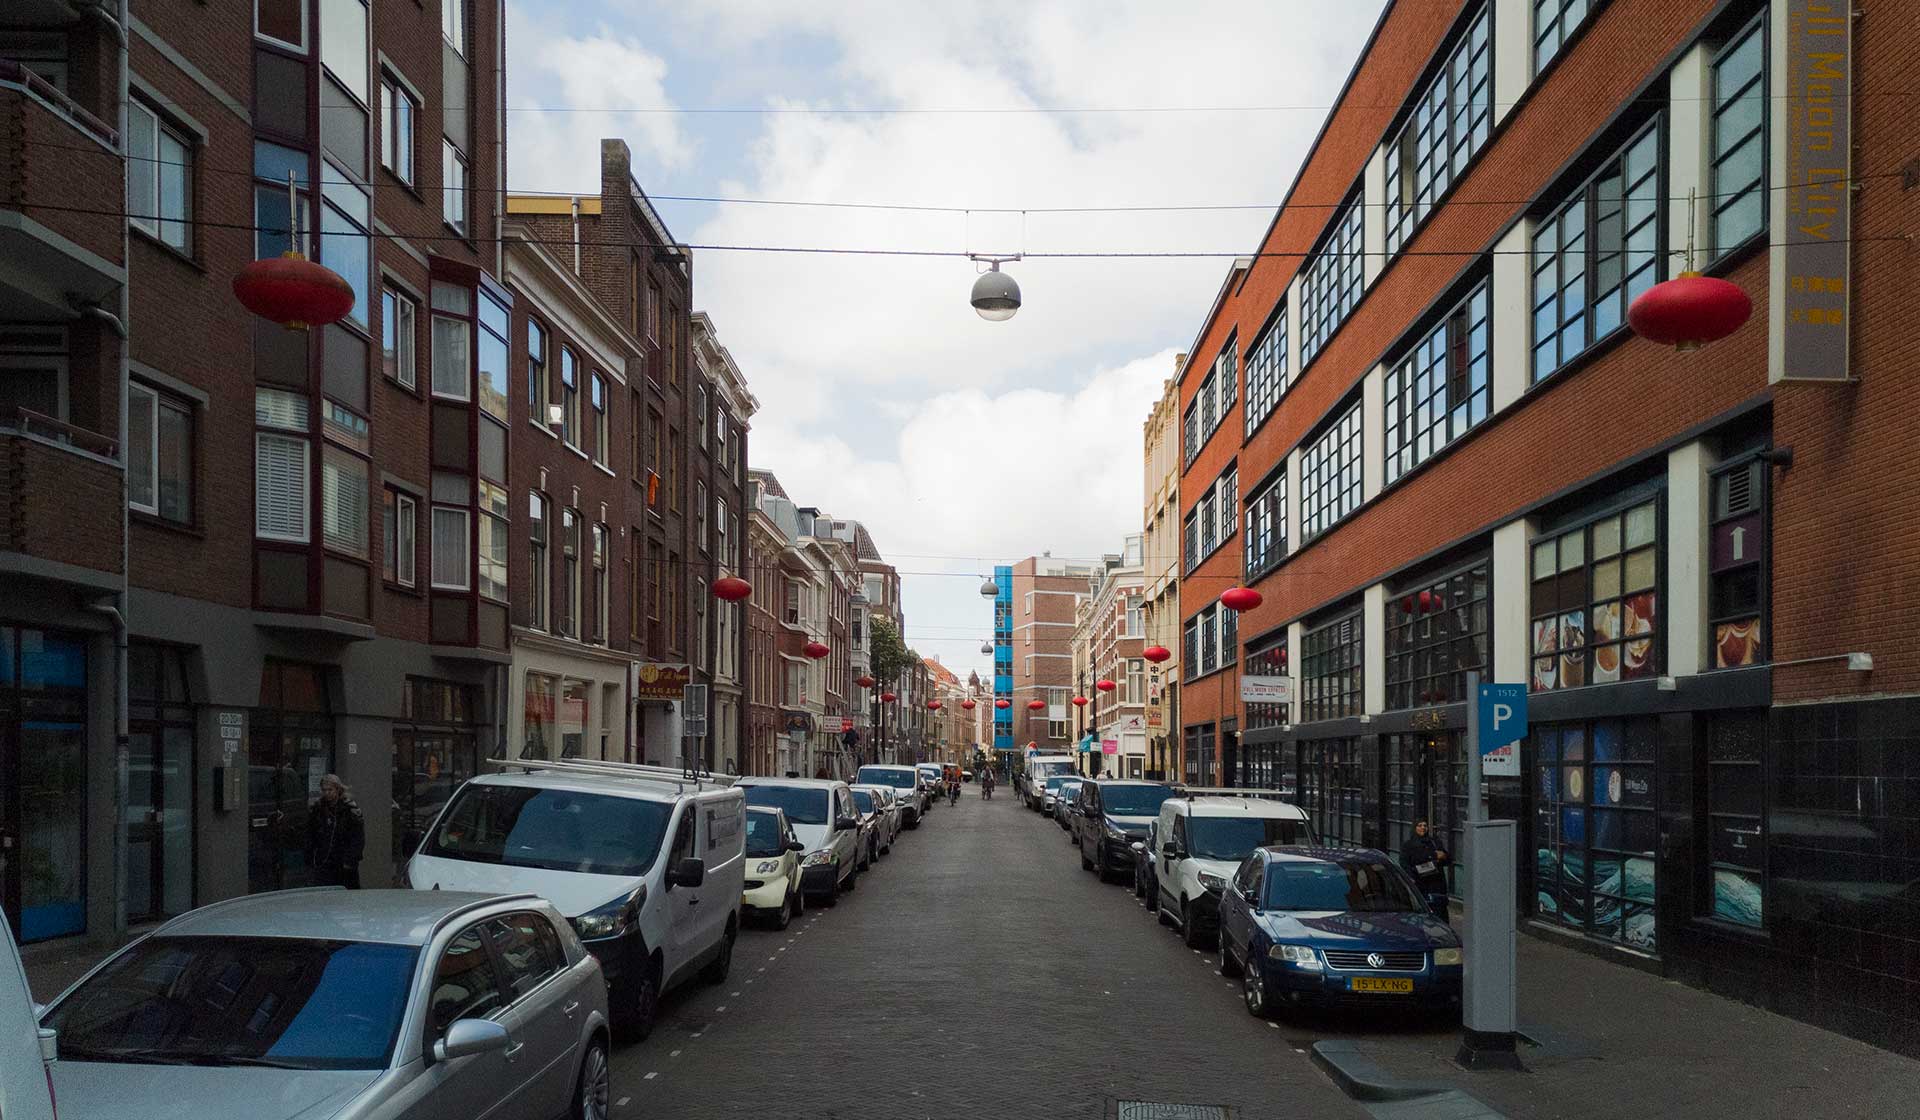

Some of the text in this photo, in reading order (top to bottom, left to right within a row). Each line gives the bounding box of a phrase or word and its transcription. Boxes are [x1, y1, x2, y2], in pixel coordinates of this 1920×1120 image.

[1806, 52, 1846, 152] Moon
[1799, 167, 1846, 242] City
[1497, 689, 1518, 697] 1512
[1493, 703, 1513, 731] P
[1357, 978, 1408, 990] 15-LX-NG
